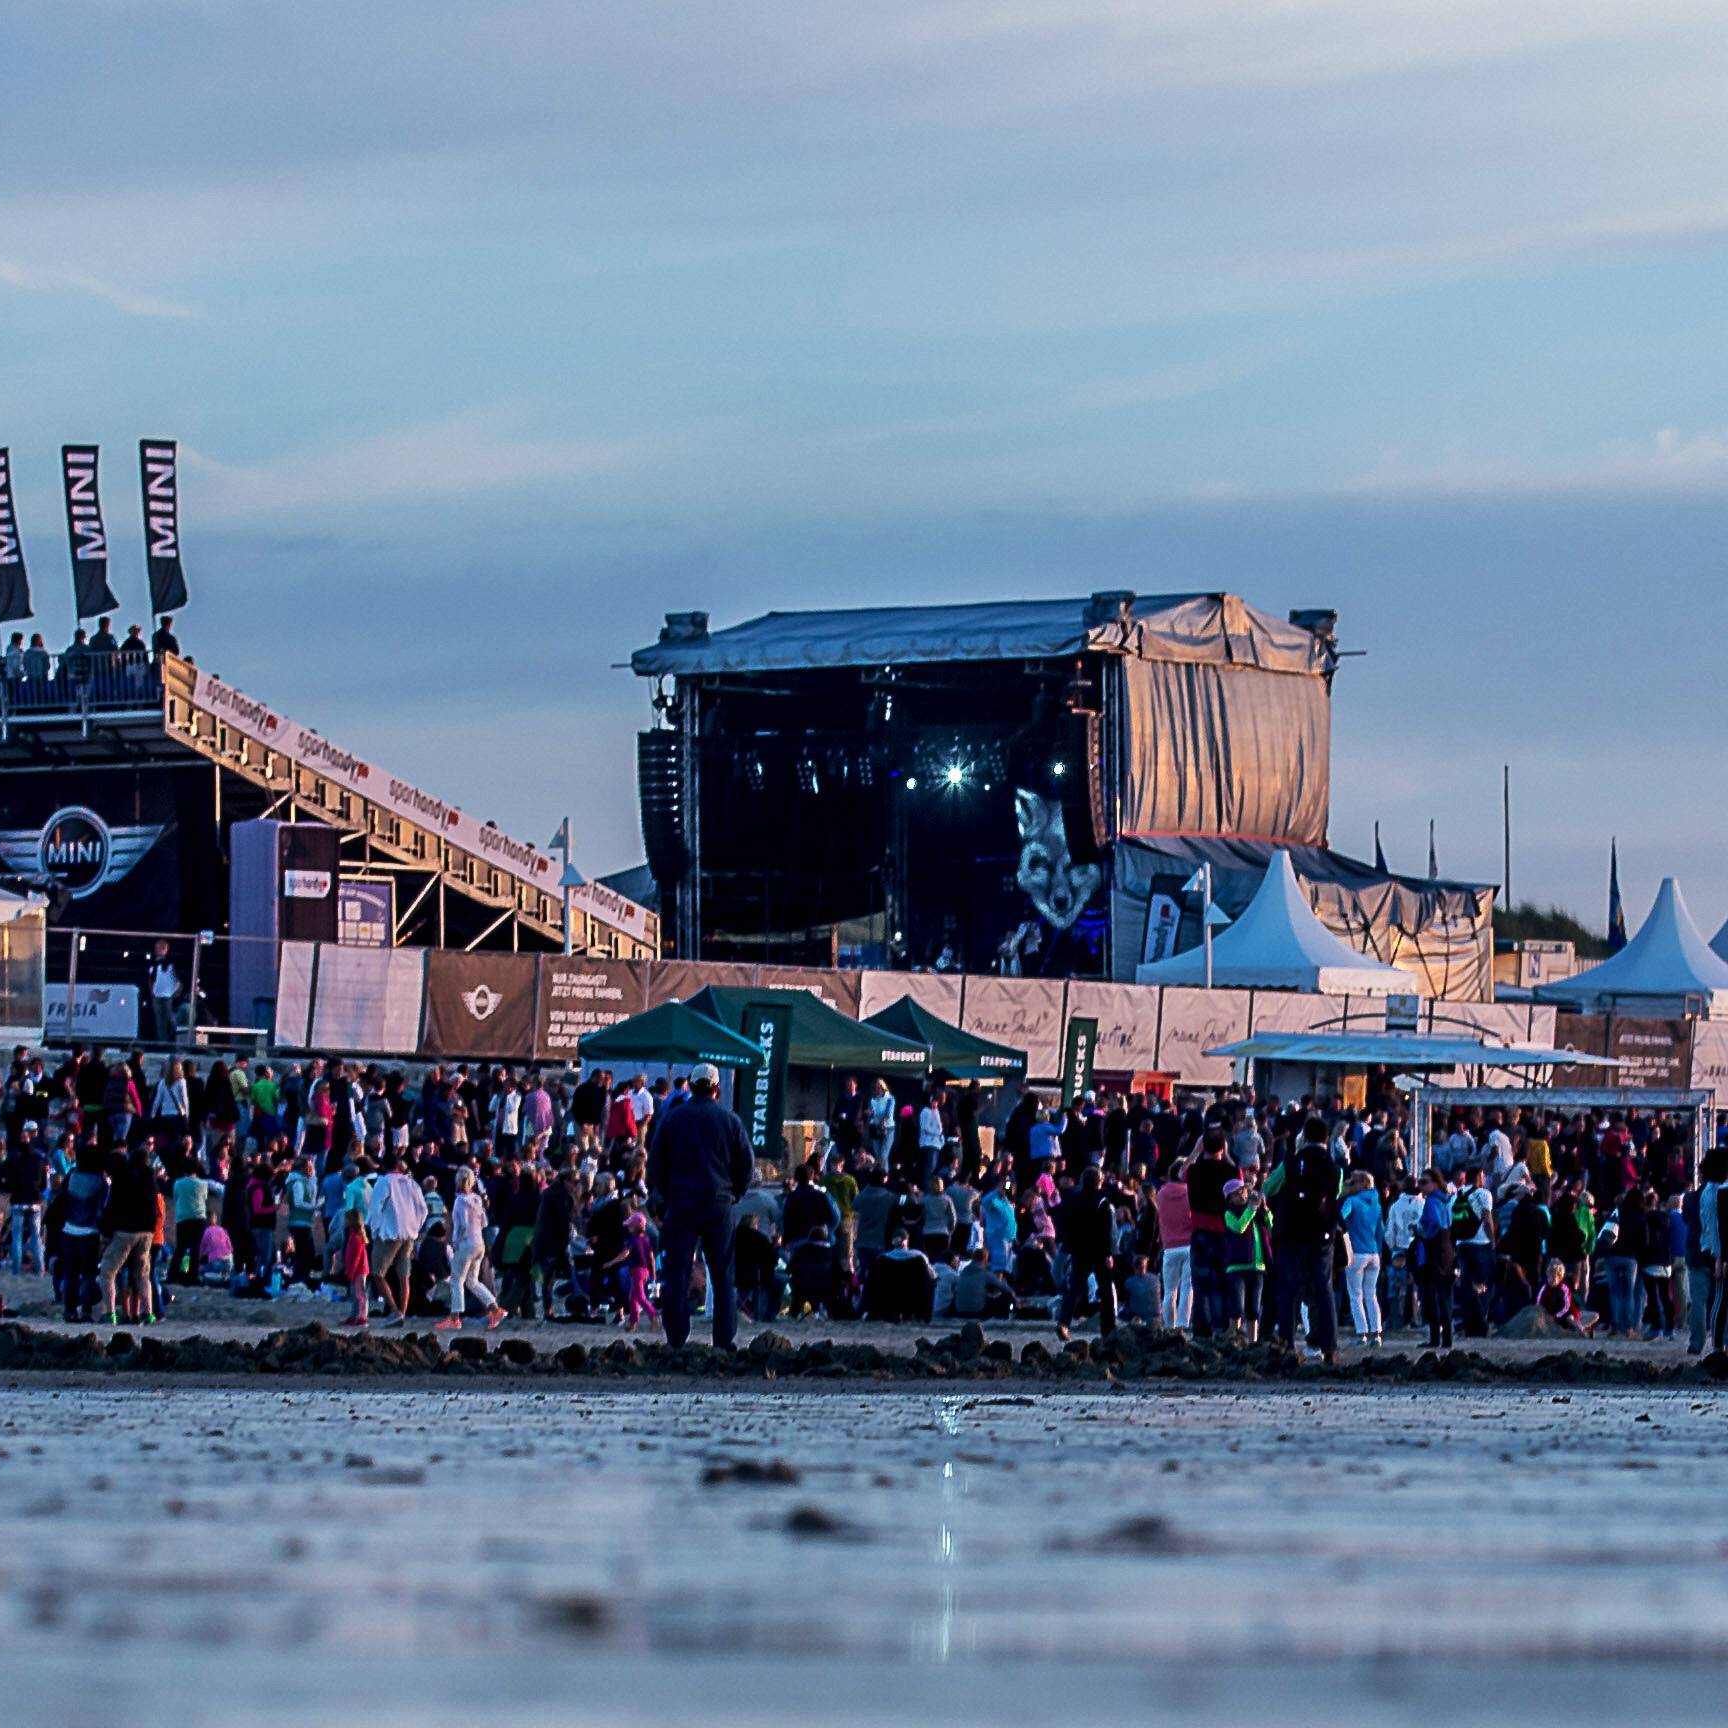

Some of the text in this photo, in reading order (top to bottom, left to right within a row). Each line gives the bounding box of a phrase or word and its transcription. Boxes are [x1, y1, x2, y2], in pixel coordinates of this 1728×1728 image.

[66, 452, 108, 559] MINI
[145, 447, 177, 558] MINI
[389, 779, 449, 830] sparhandy
[47, 841, 101, 864] MINI
[478, 826, 539, 875] sparhandy
[573, 880, 627, 923] parhandy
[47, 1003, 98, 1018] FRSIA
